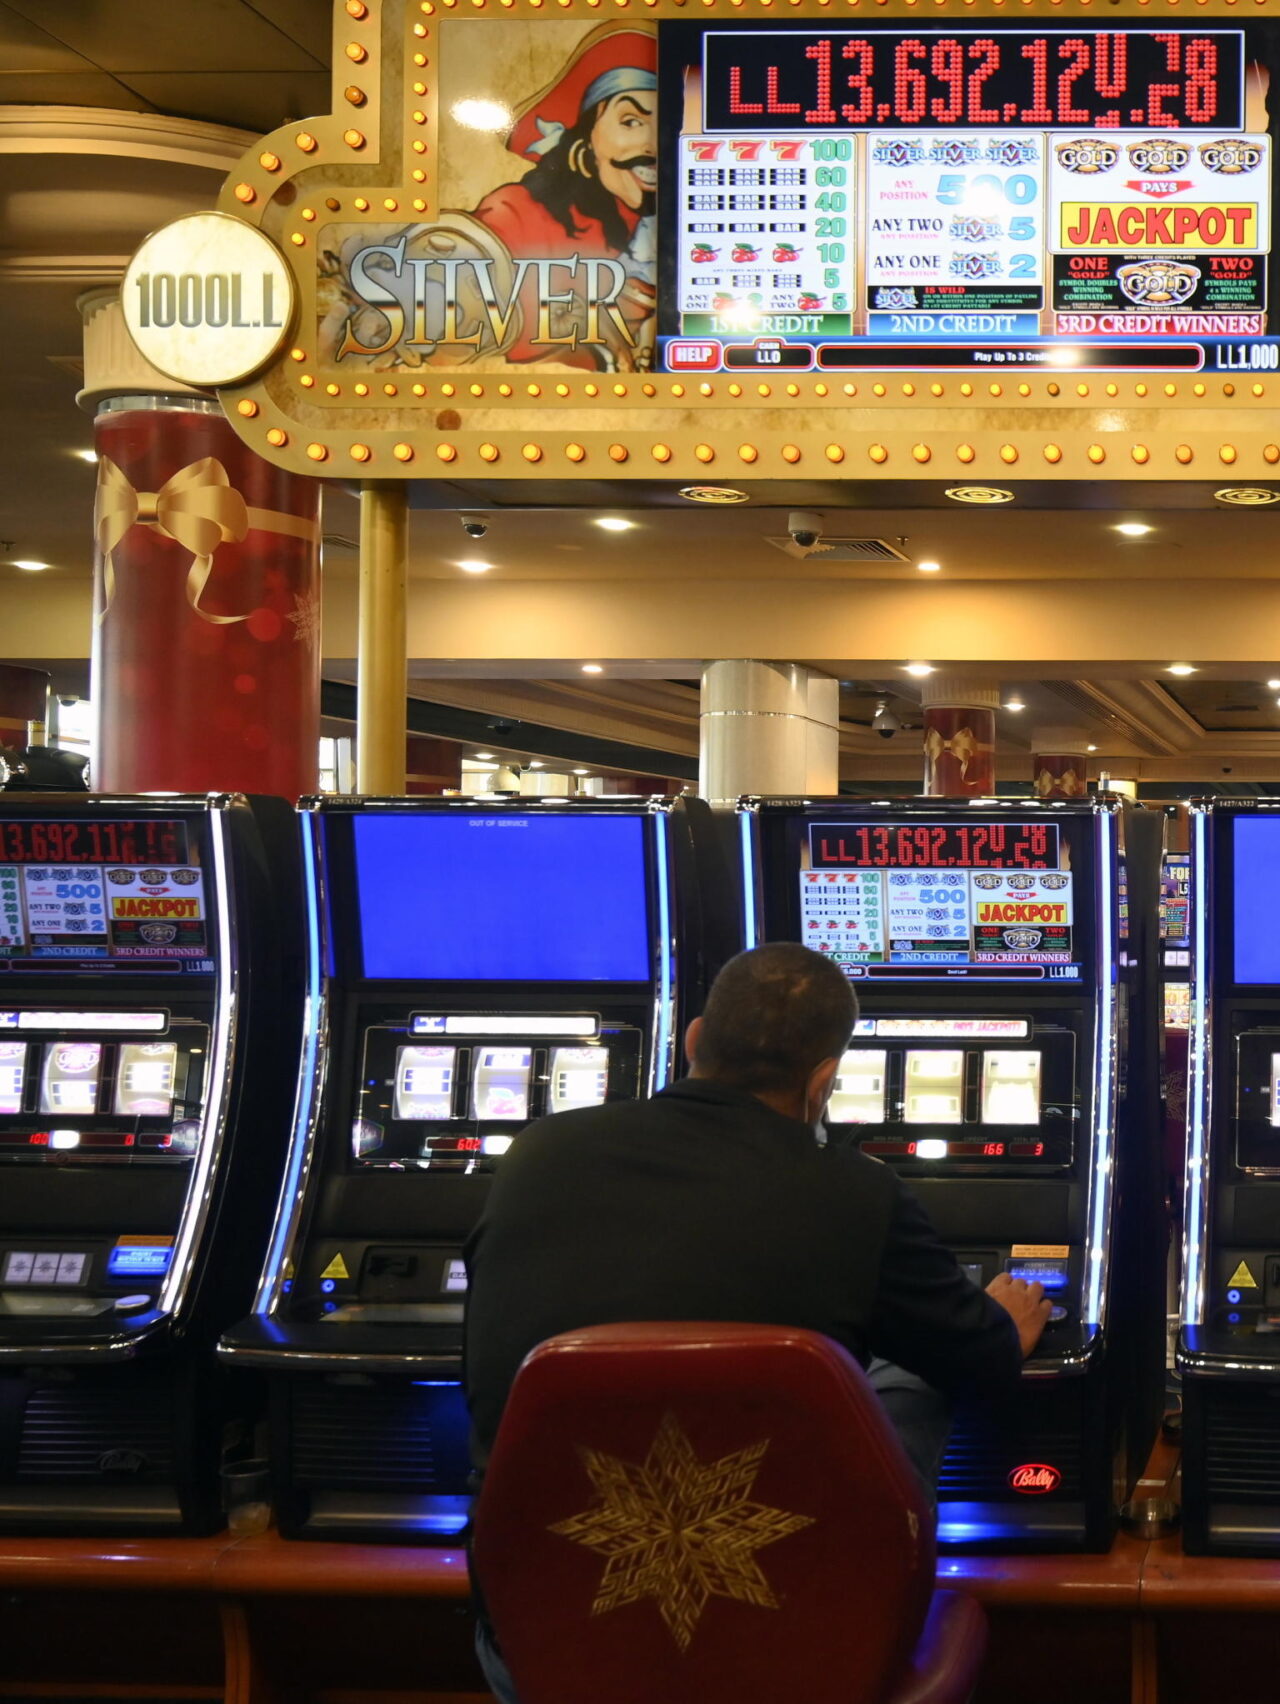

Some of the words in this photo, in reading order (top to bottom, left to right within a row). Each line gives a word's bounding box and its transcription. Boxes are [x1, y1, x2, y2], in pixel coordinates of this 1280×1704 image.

[688, 139, 726, 162] 7
[729, 139, 766, 162] 7
[770, 139, 807, 162] 7
[809, 139, 852, 162] 100
[872, 148, 928, 161] SILVER
[928, 148, 984, 161] SILVER
[984, 148, 1040, 161] SILVER
[1061, 150, 1117, 166] GOLD
[1132, 150, 1188, 166] GOLD
[1203, 150, 1259, 166] GOLD
[815, 167, 846, 187] 60
[1141, 182, 1178, 193] PAYS
[815, 192, 846, 212] 40
[879, 191, 928, 200] POSITION
[815, 217, 846, 237] 20
[872, 218, 905, 231] ANY
[909, 218, 943, 231] TWO
[949, 223, 1004, 235] SILVER
[1008, 216, 1036, 241] 5
[1067, 206, 1252, 245] JACKPOT
[816, 242, 845, 263] 10
[874, 255, 905, 268] ANY
[910, 255, 941, 268] ONE
[949, 260, 1003, 273] SILVER
[1008, 253, 1037, 278] 2
[1069, 257, 1108, 270] ONE
[1209, 257, 1254, 270] TWO
[824, 267, 840, 289] 5
[1127, 274, 1191, 293] GOLD
[336, 237, 637, 362] SILVER
[832, 292, 847, 310] 5
[890, 315, 935, 333] 2ND
[938, 315, 1017, 333] CREDIT
[1058, 315, 1096, 333] 3RD
[1098, 315, 1170, 333] CREDIT
[1173, 315, 1260, 333] WINNERS
[676, 347, 713, 362] HELP
[56, 884, 101, 899] 500
[919, 889, 966, 904] 500
[115, 899, 197, 917] JACKPOT
[979, 904, 1064, 922] JACKPOT
[953, 925, 967, 936] 2
[834, 952, 870, 960] CREDIT
[977, 953, 994, 962] 3RD
[995, 953, 1028, 962] CREDIT
[1030, 953, 1069, 962] WINNERS
[124, 1135, 133, 1146] 0
[163, 1135, 171, 1146] 3
[457, 1139, 481, 1150] 602
[908, 1143, 916, 1155] 0
[983, 1143, 1004, 1155] 166
[1035, 1143, 1043, 1155] 3
[1013, 1468, 1054, 1489] Bally
